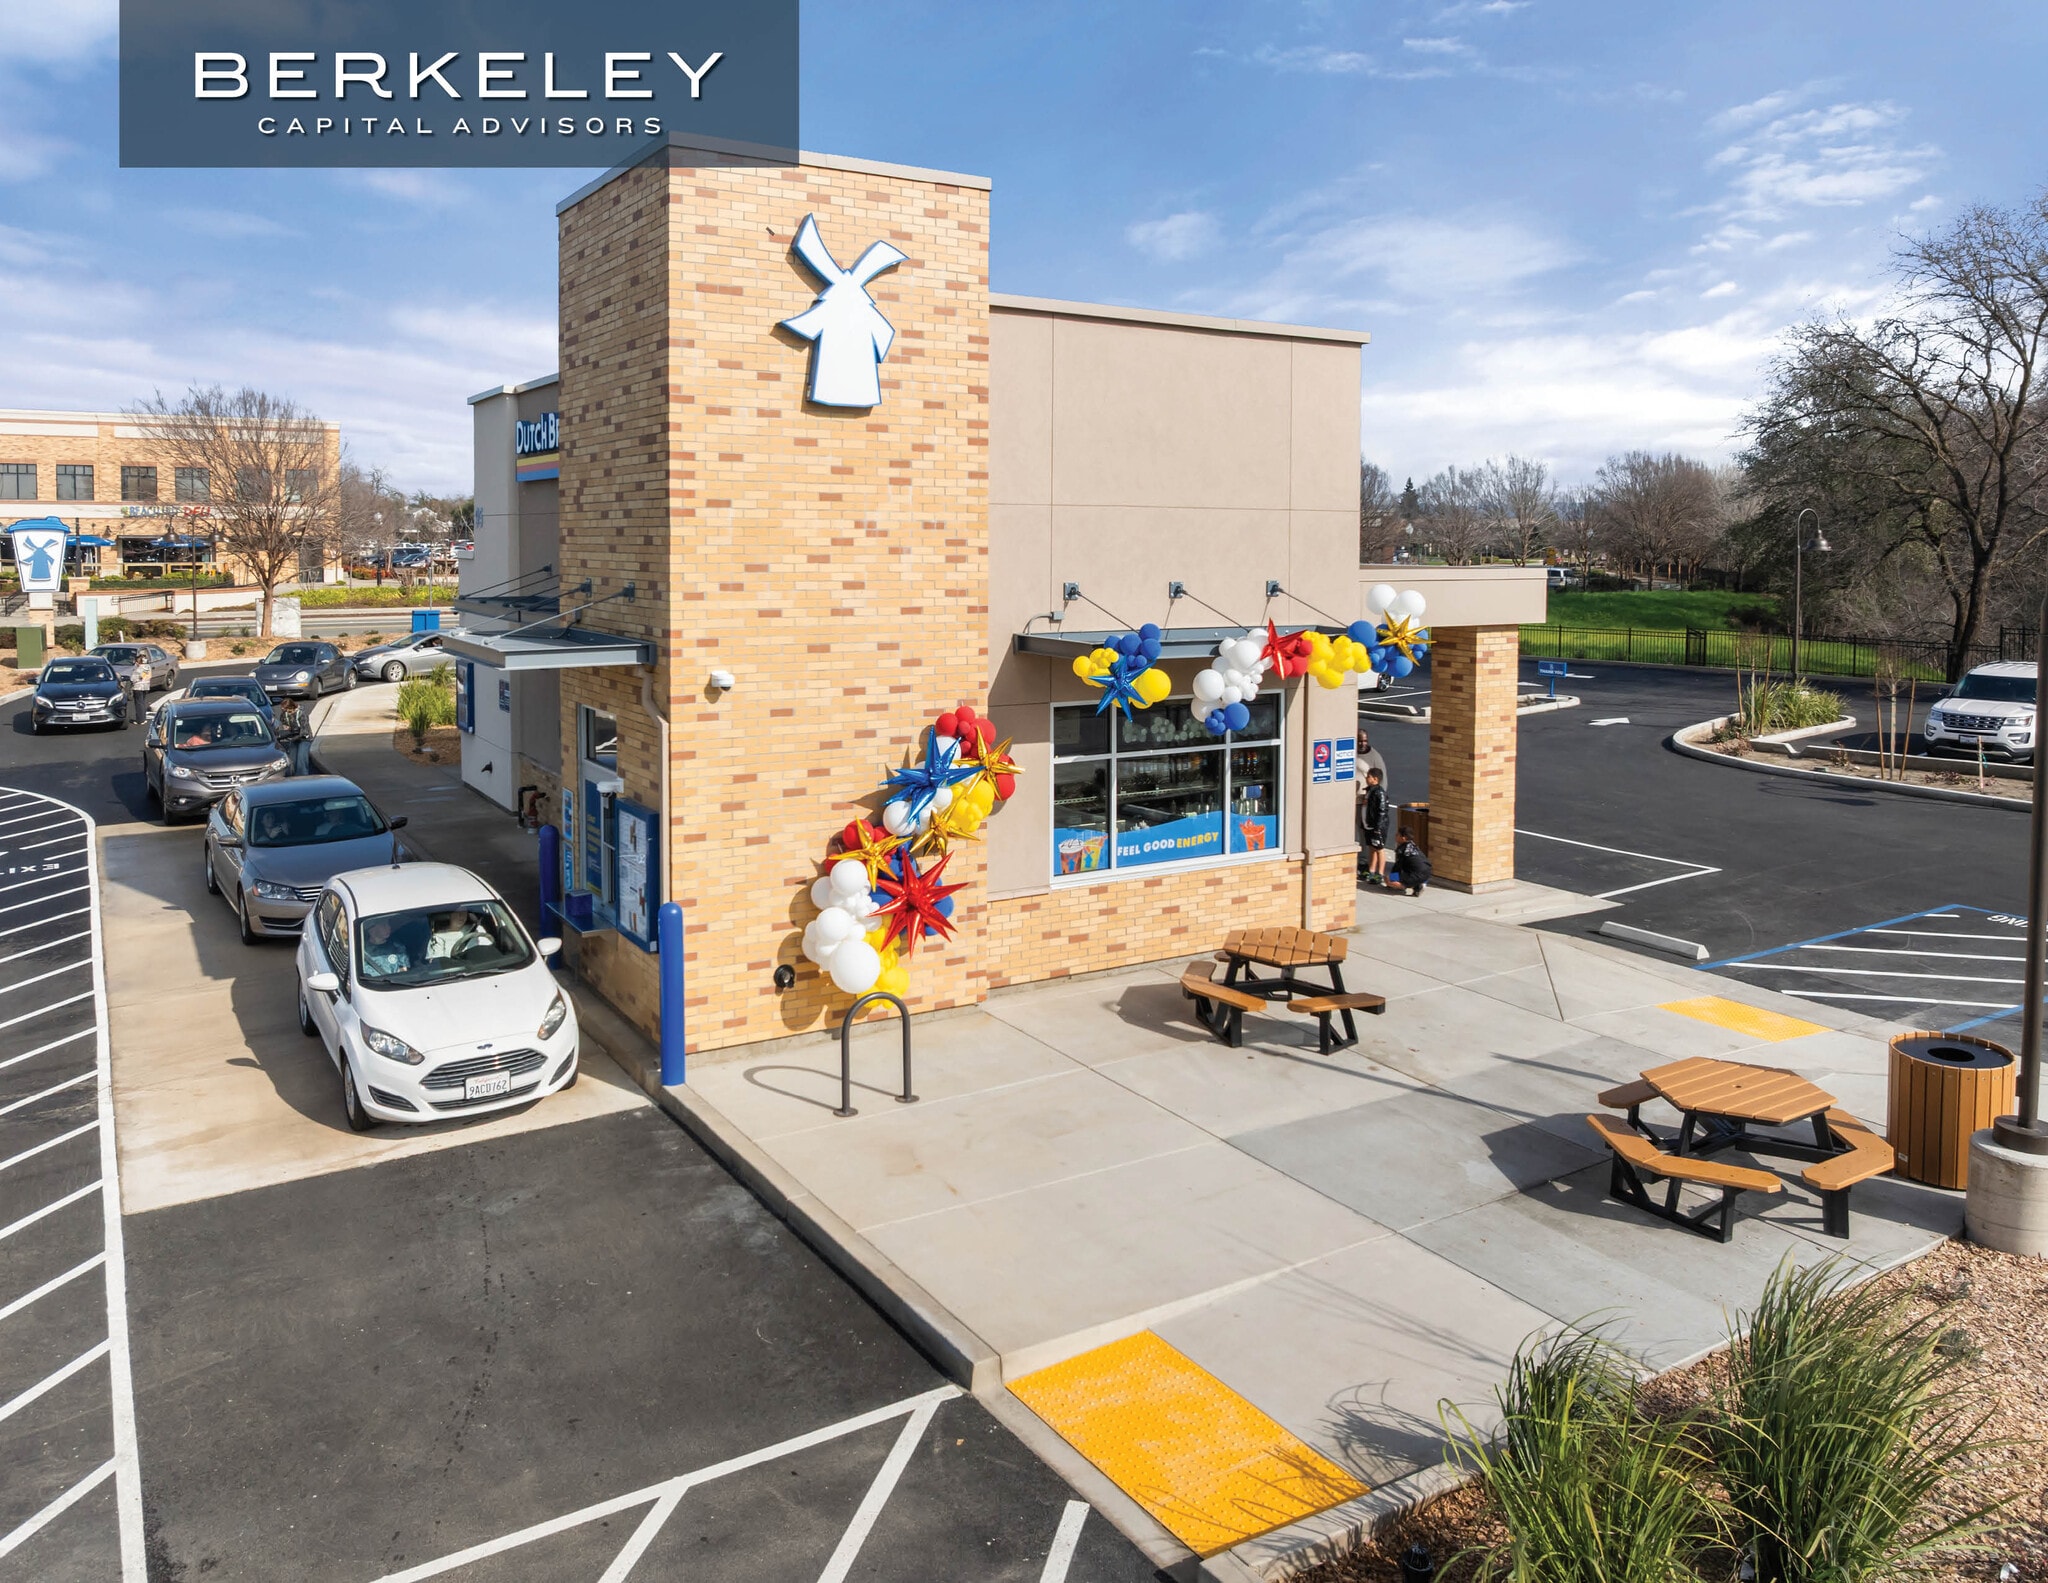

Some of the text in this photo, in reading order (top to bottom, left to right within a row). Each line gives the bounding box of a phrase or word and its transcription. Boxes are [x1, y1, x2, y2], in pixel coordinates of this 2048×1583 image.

[516, 413, 548, 454] DUTCH
[1117, 831, 1220, 857] FEEL GOOD ENERGY
